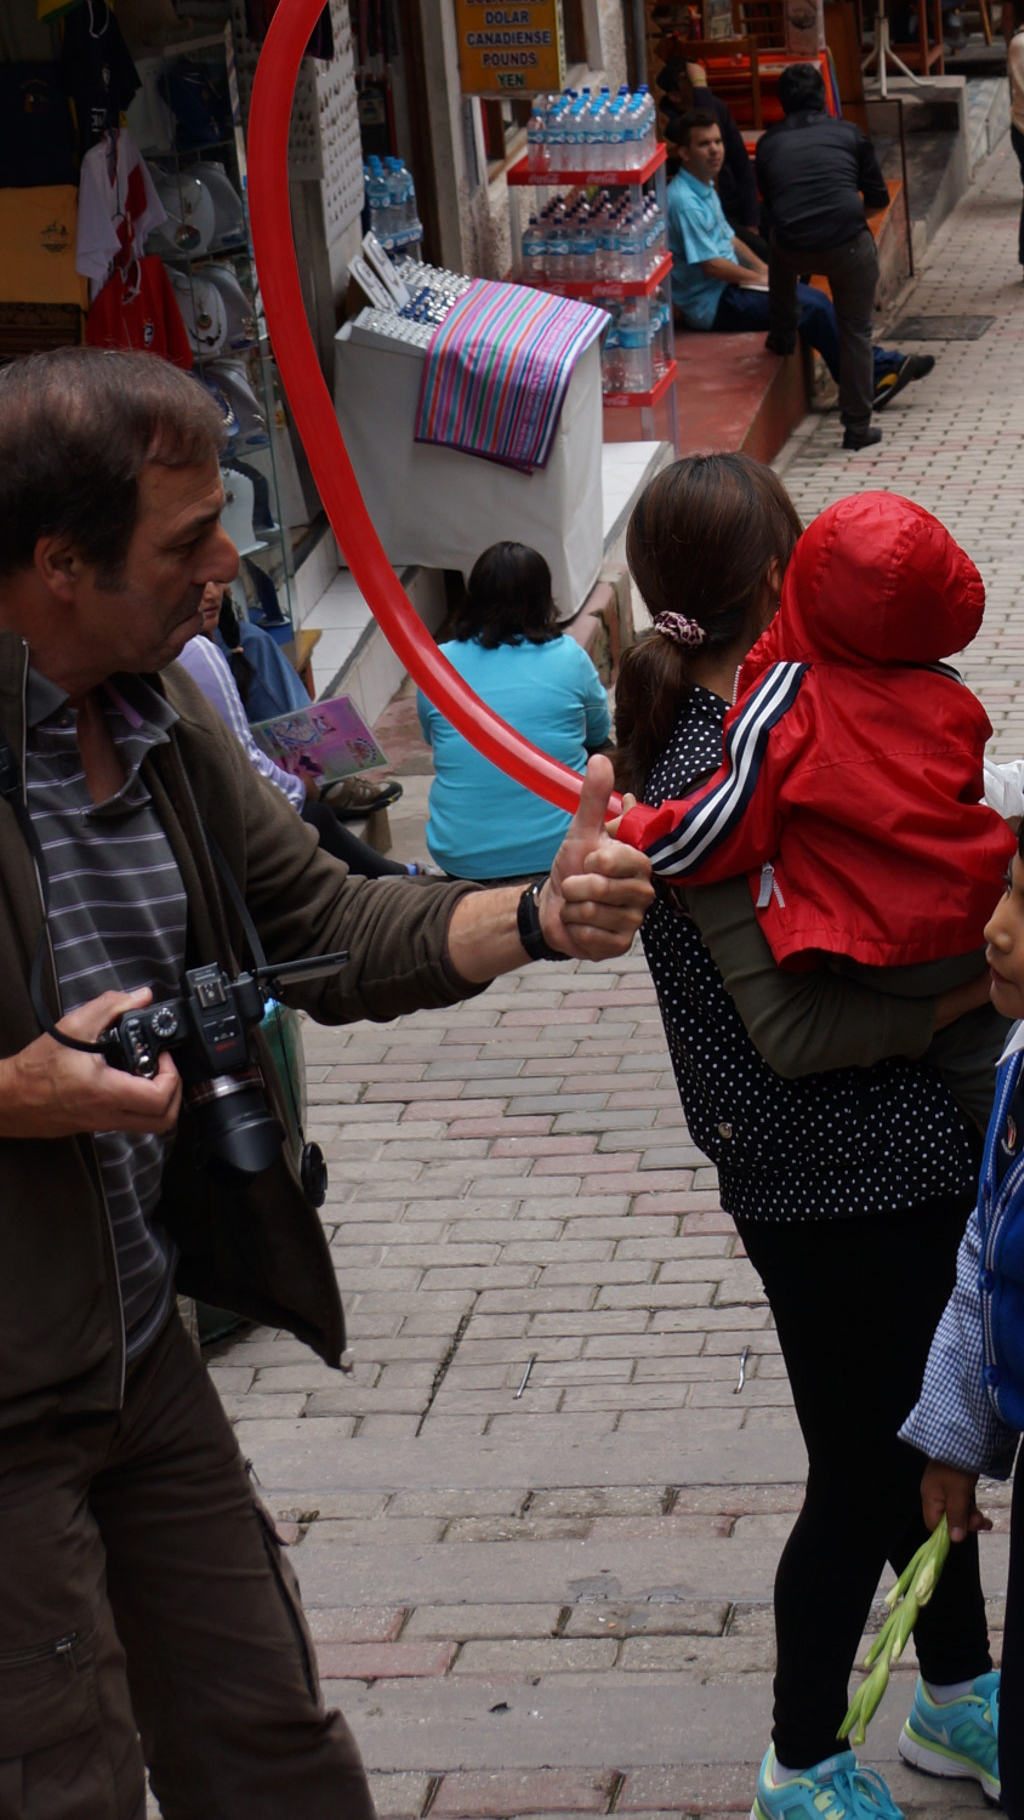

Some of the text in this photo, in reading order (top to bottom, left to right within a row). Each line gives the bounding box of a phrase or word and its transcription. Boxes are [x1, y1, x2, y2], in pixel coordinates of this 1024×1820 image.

[485, 11, 530, 25] DOLAR
[467, 31, 551, 47] CANADIENSE
[483, 52, 538, 67] POUNDS
[498, 73, 525, 88] YEN
